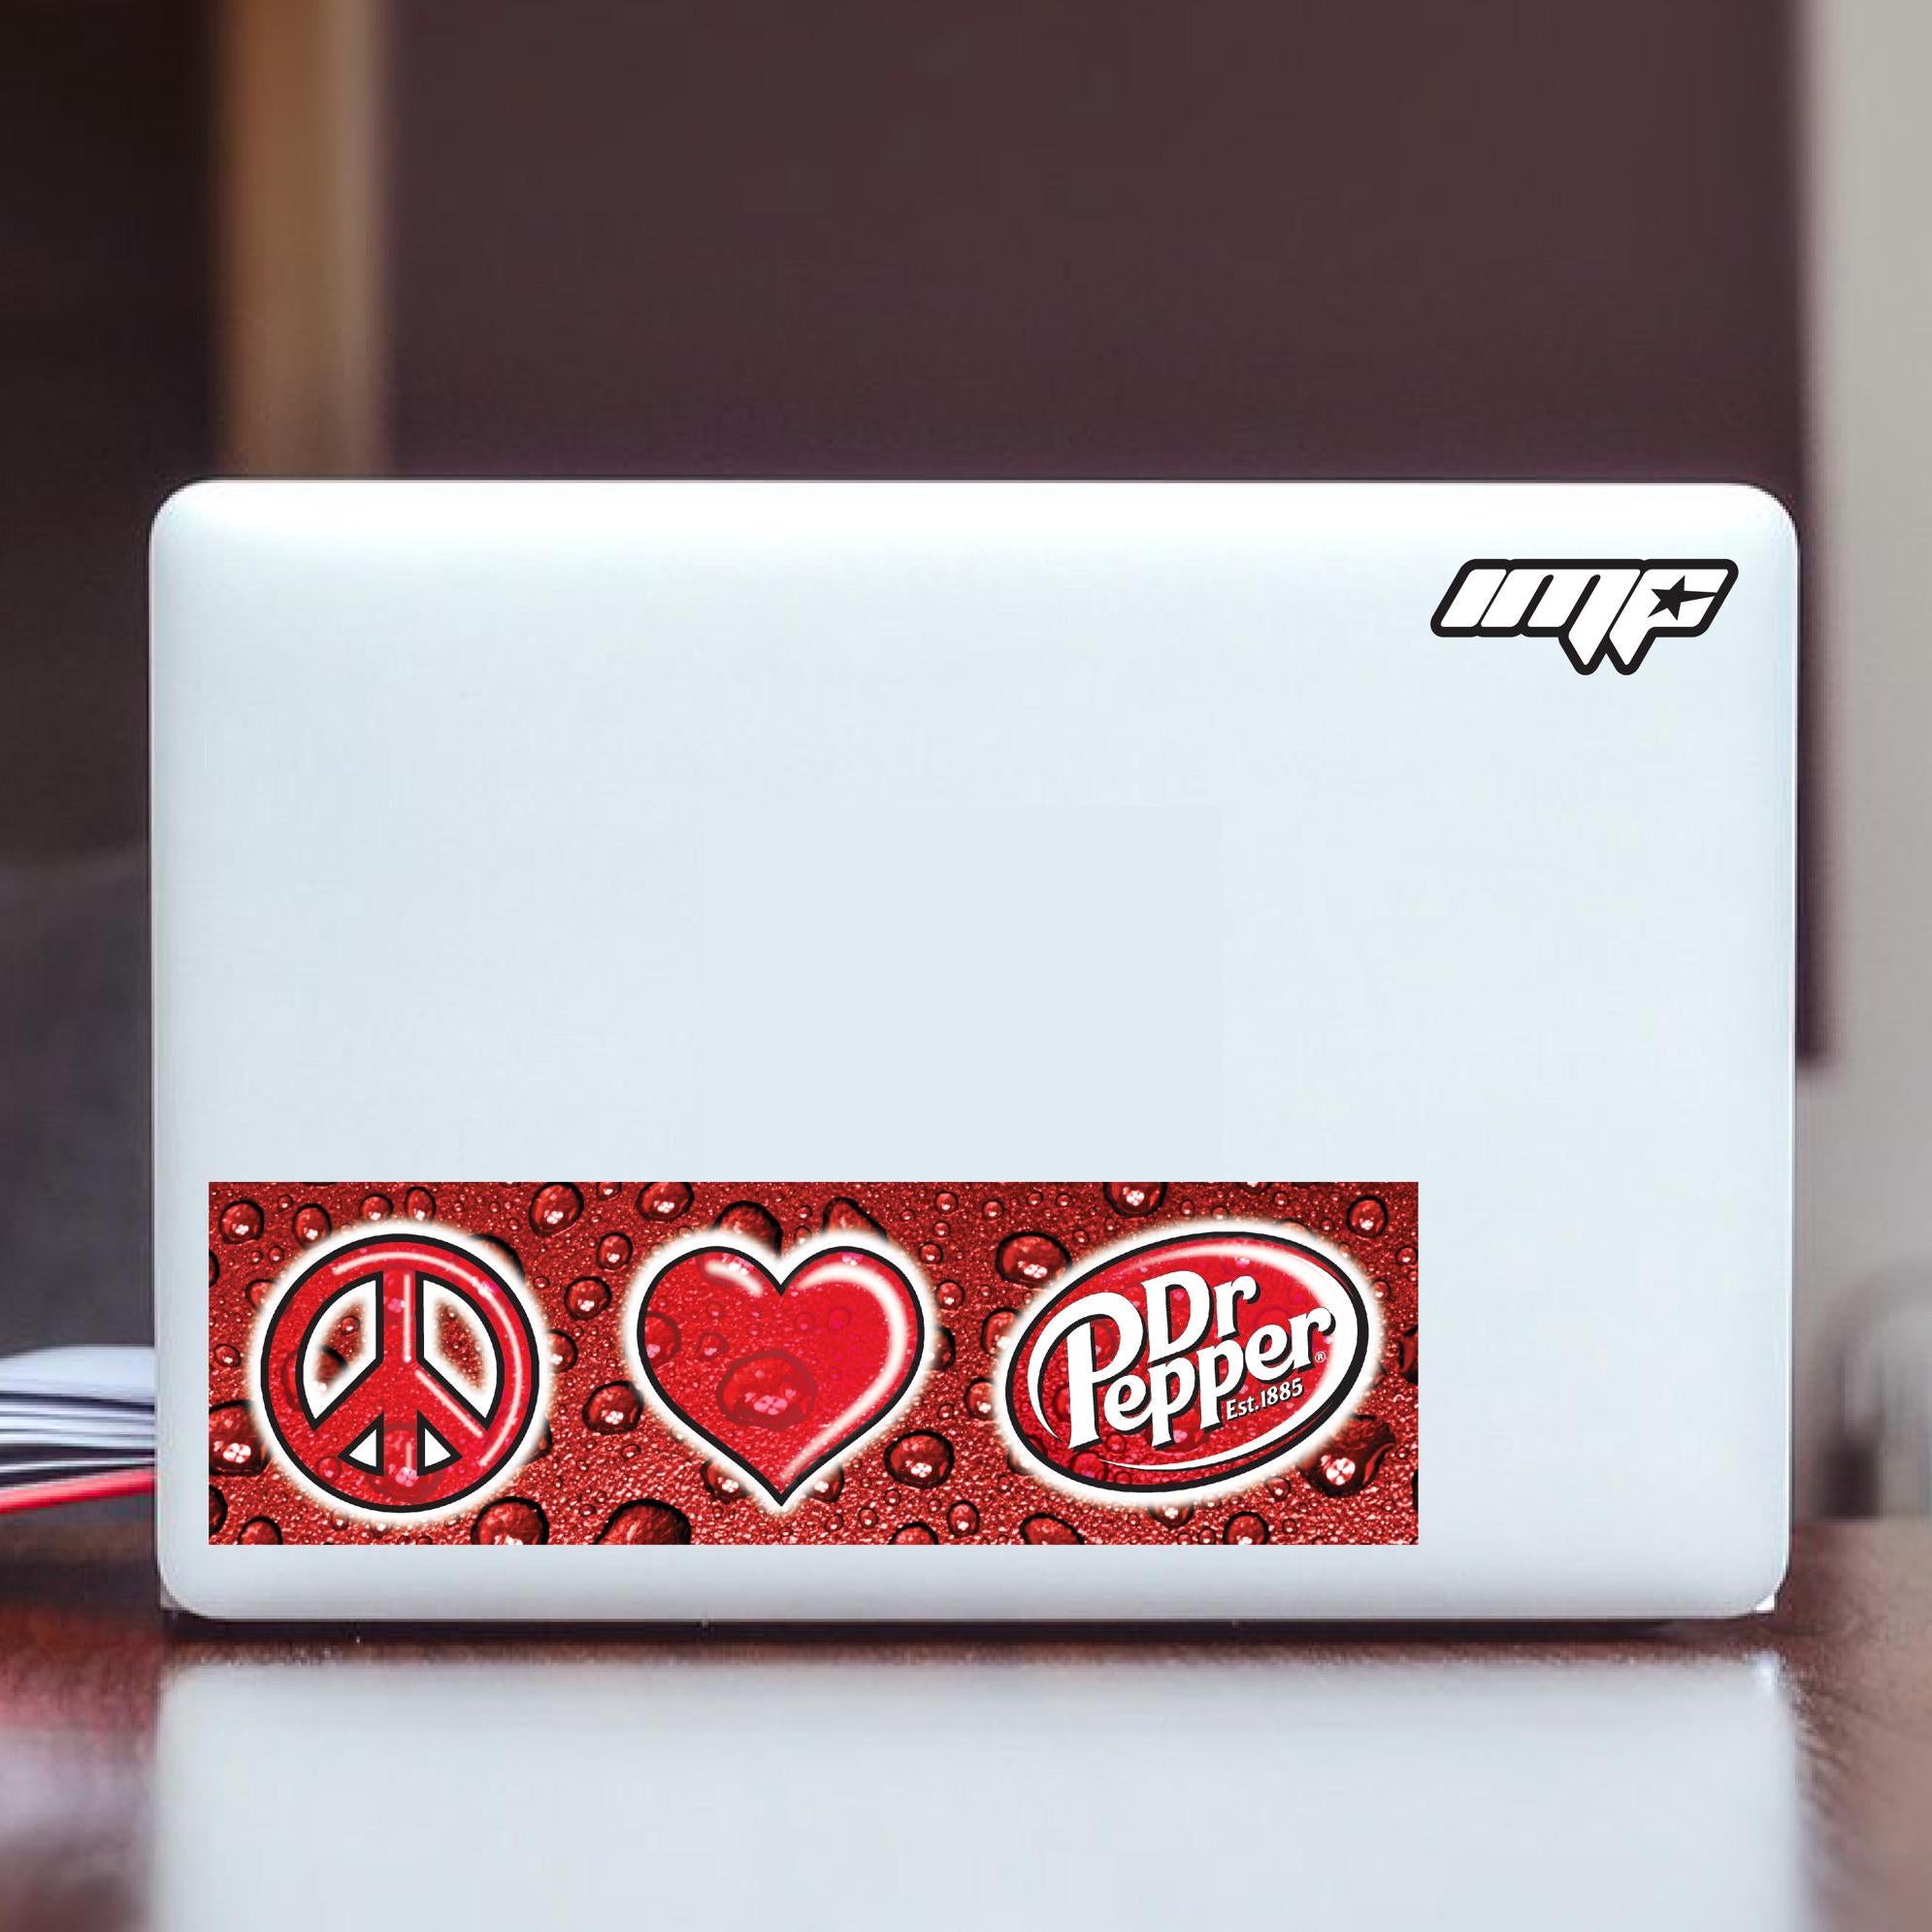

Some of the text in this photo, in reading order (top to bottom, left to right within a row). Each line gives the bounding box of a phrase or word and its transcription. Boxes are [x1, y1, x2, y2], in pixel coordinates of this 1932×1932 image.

[1141, 1270, 1260, 1363] Dr
[1028, 1293, 1335, 1449] Pepper
[1226, 1377, 1303, 1421] Est. 1885
